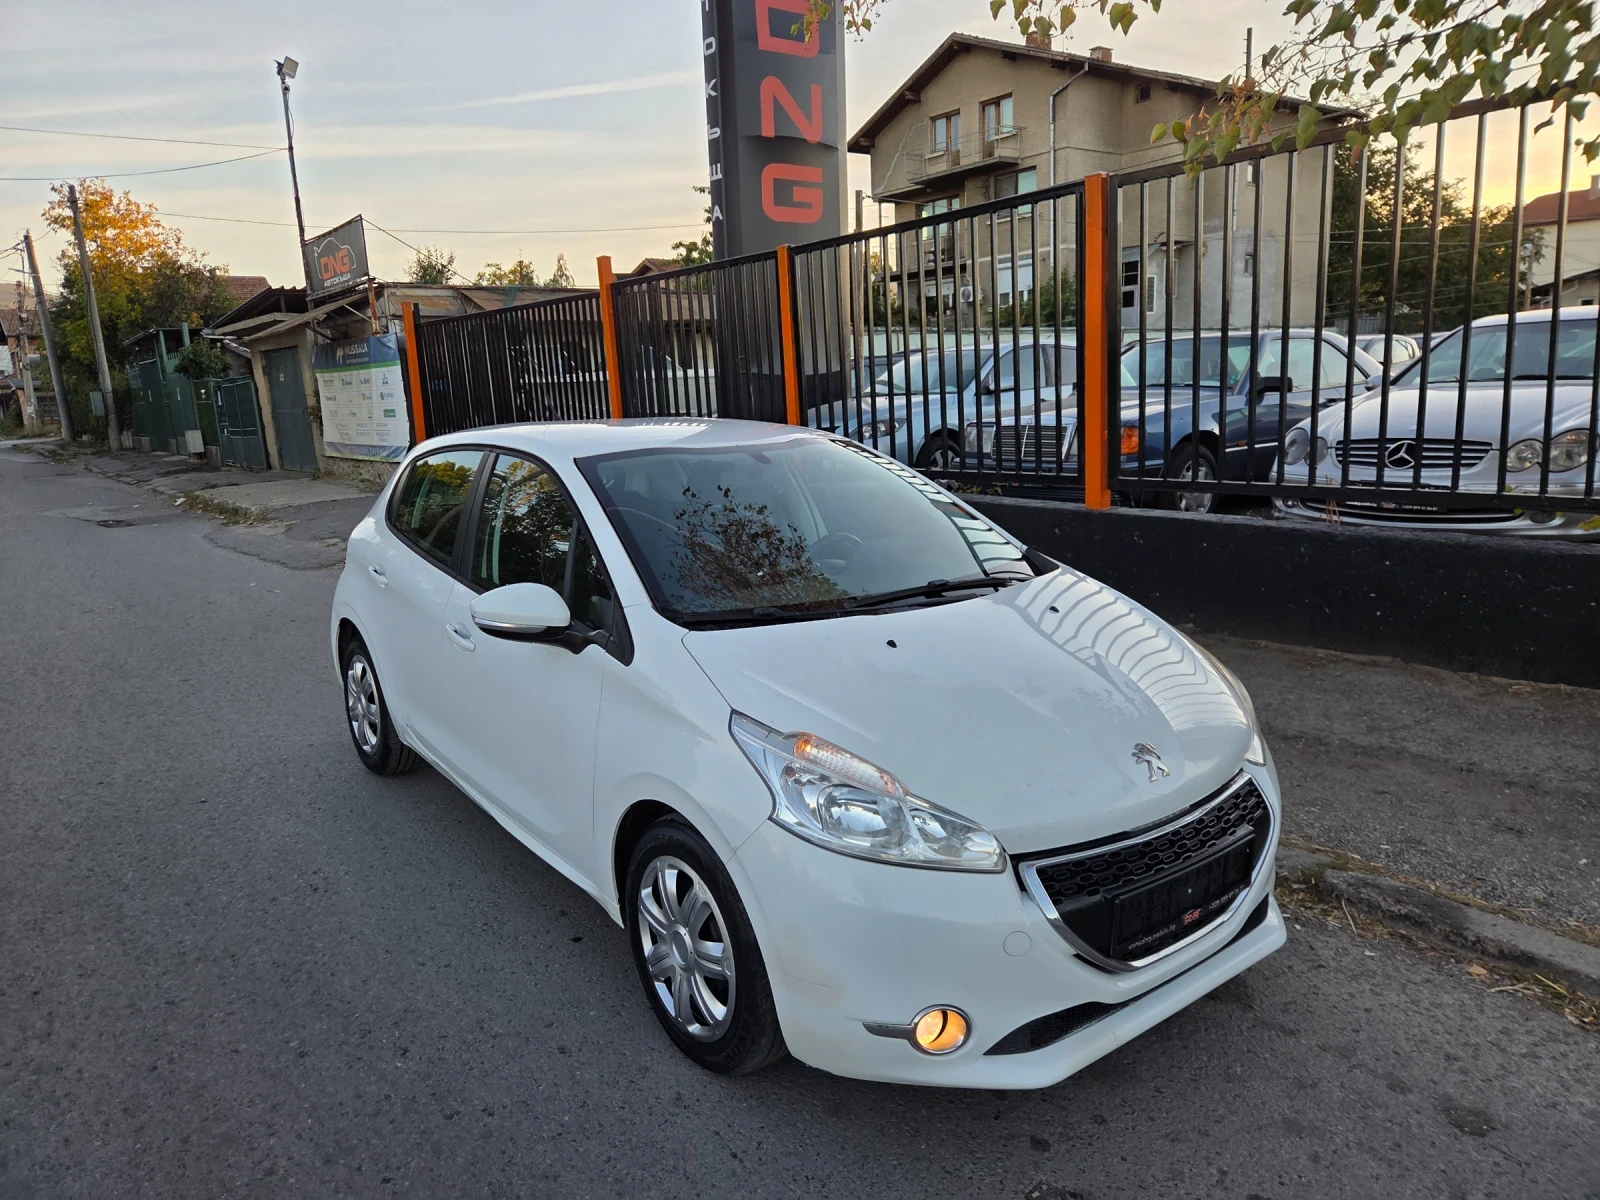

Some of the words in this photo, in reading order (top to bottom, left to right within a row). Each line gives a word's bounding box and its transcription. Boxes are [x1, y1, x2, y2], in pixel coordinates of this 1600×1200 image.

[755, 0, 823, 224] DNG
[320, 247, 350, 280] DNG
[344, 342, 369, 356] MUSSALA
